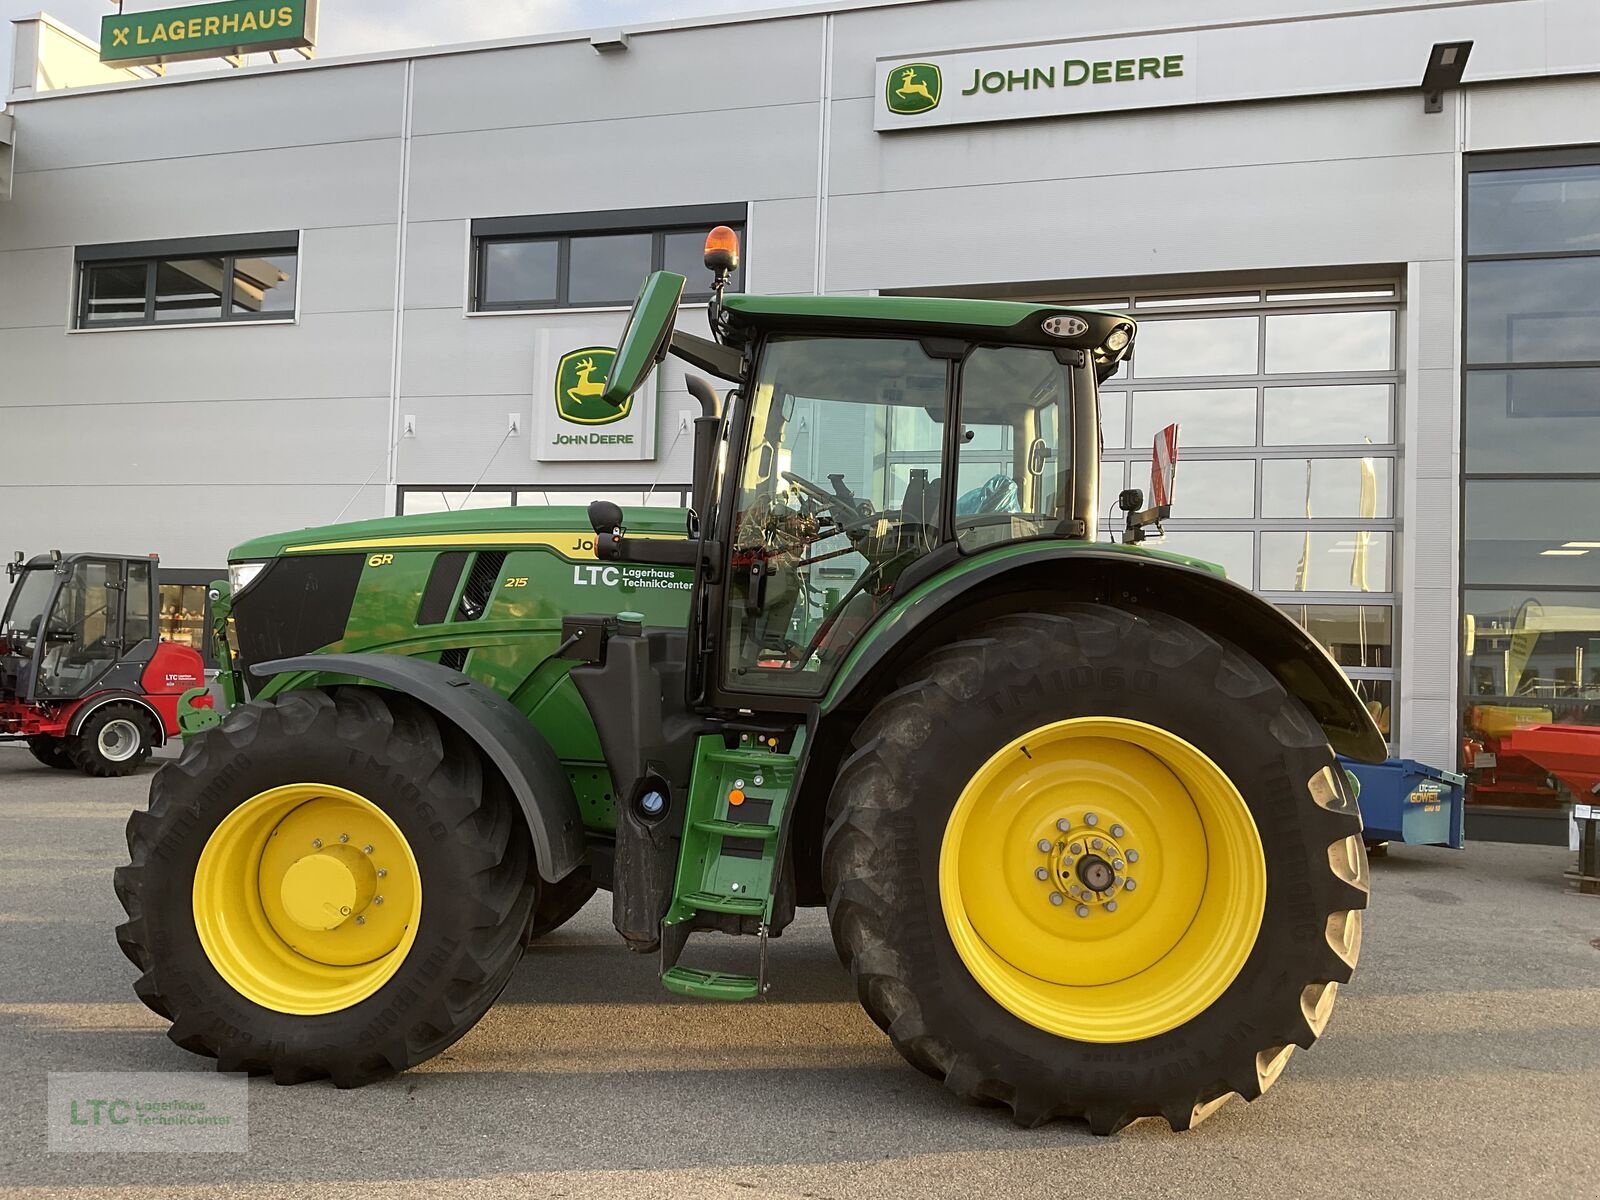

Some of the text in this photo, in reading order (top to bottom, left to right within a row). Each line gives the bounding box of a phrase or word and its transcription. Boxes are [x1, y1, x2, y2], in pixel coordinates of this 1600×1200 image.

[136, 6, 293, 45] LAGERHAUS
[962, 54, 1184, 96] JOHN DEERE
[552, 433, 634, 445] JOHN DEERE
[368, 554, 394, 568] 6R
[573, 566, 619, 586] LTC
[622, 567, 675, 579] Lagerhaus
[504, 577, 529, 588] 215
[622, 578, 694, 591] TechnikCenter
